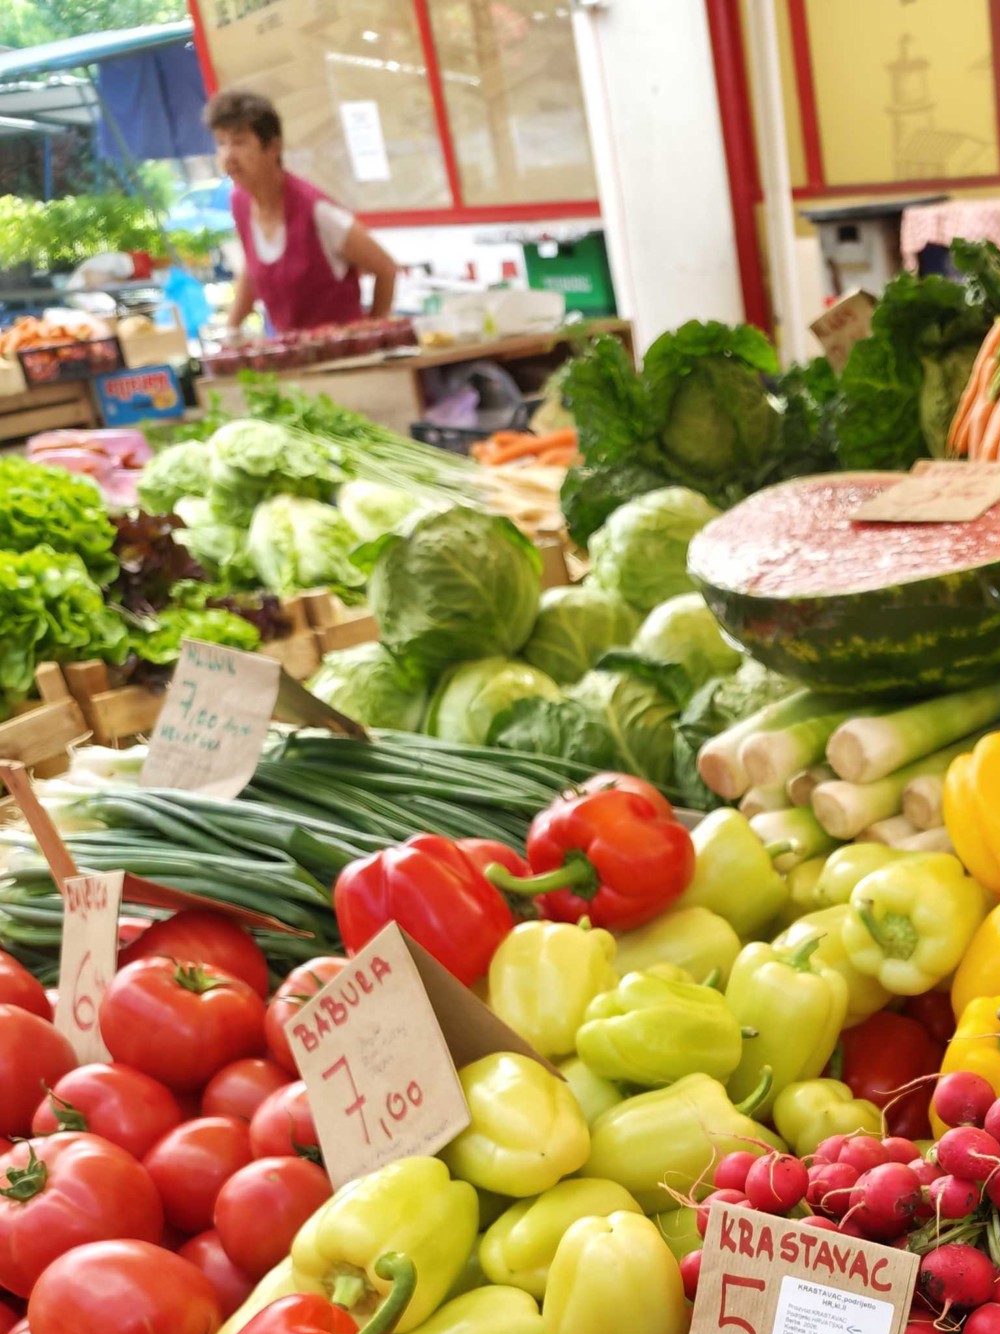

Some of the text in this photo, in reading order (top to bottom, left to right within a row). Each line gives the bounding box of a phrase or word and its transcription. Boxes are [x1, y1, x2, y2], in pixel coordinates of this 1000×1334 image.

[292, 956, 393, 1052] BABURA
[321, 1054, 424, 1145] 7,00
[719, 1210, 892, 1292] KRASTAVAC
